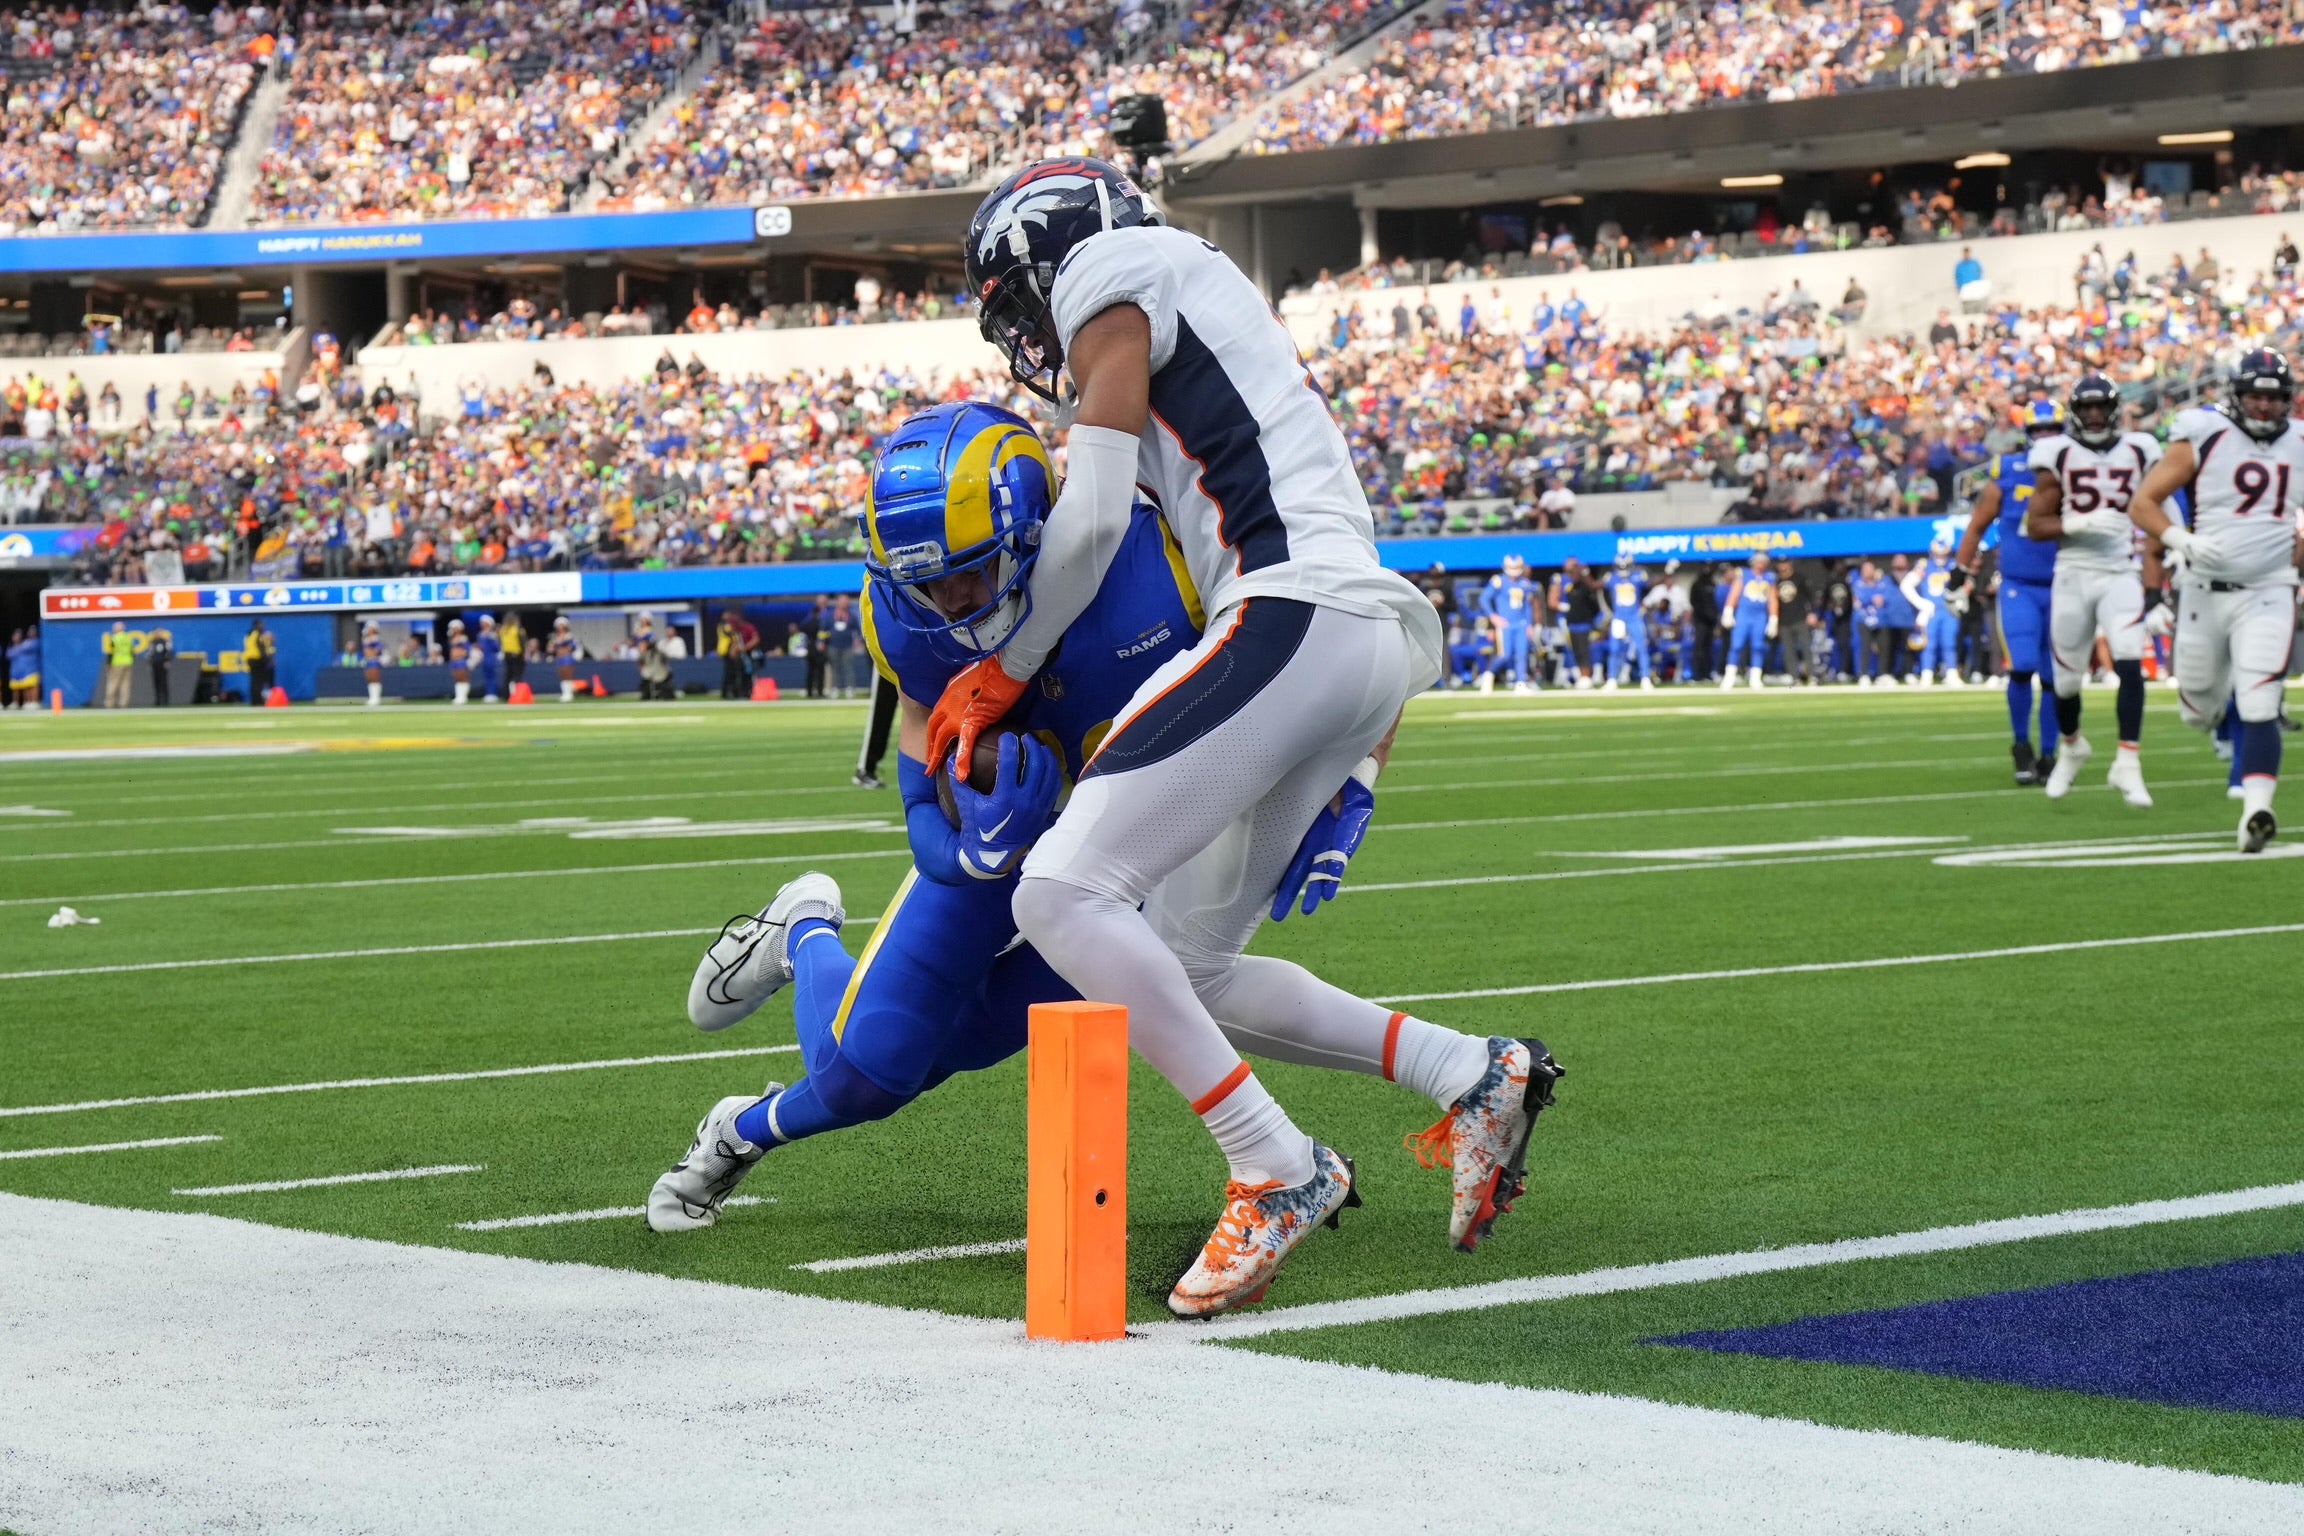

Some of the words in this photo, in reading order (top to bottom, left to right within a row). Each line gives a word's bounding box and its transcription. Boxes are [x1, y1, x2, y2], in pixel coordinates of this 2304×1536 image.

[761, 212, 786, 231] CC
[258, 238, 320, 253] HAPPY
[2068, 468, 2135, 514] 53
[2233, 460, 2292, 519] 91
[1617, 535, 1691, 554] HAPPY
[1693, 531, 1804, 552] KWANZAA
[214, 588, 231, 609] 3
[1116, 628, 1172, 659] RAMS
